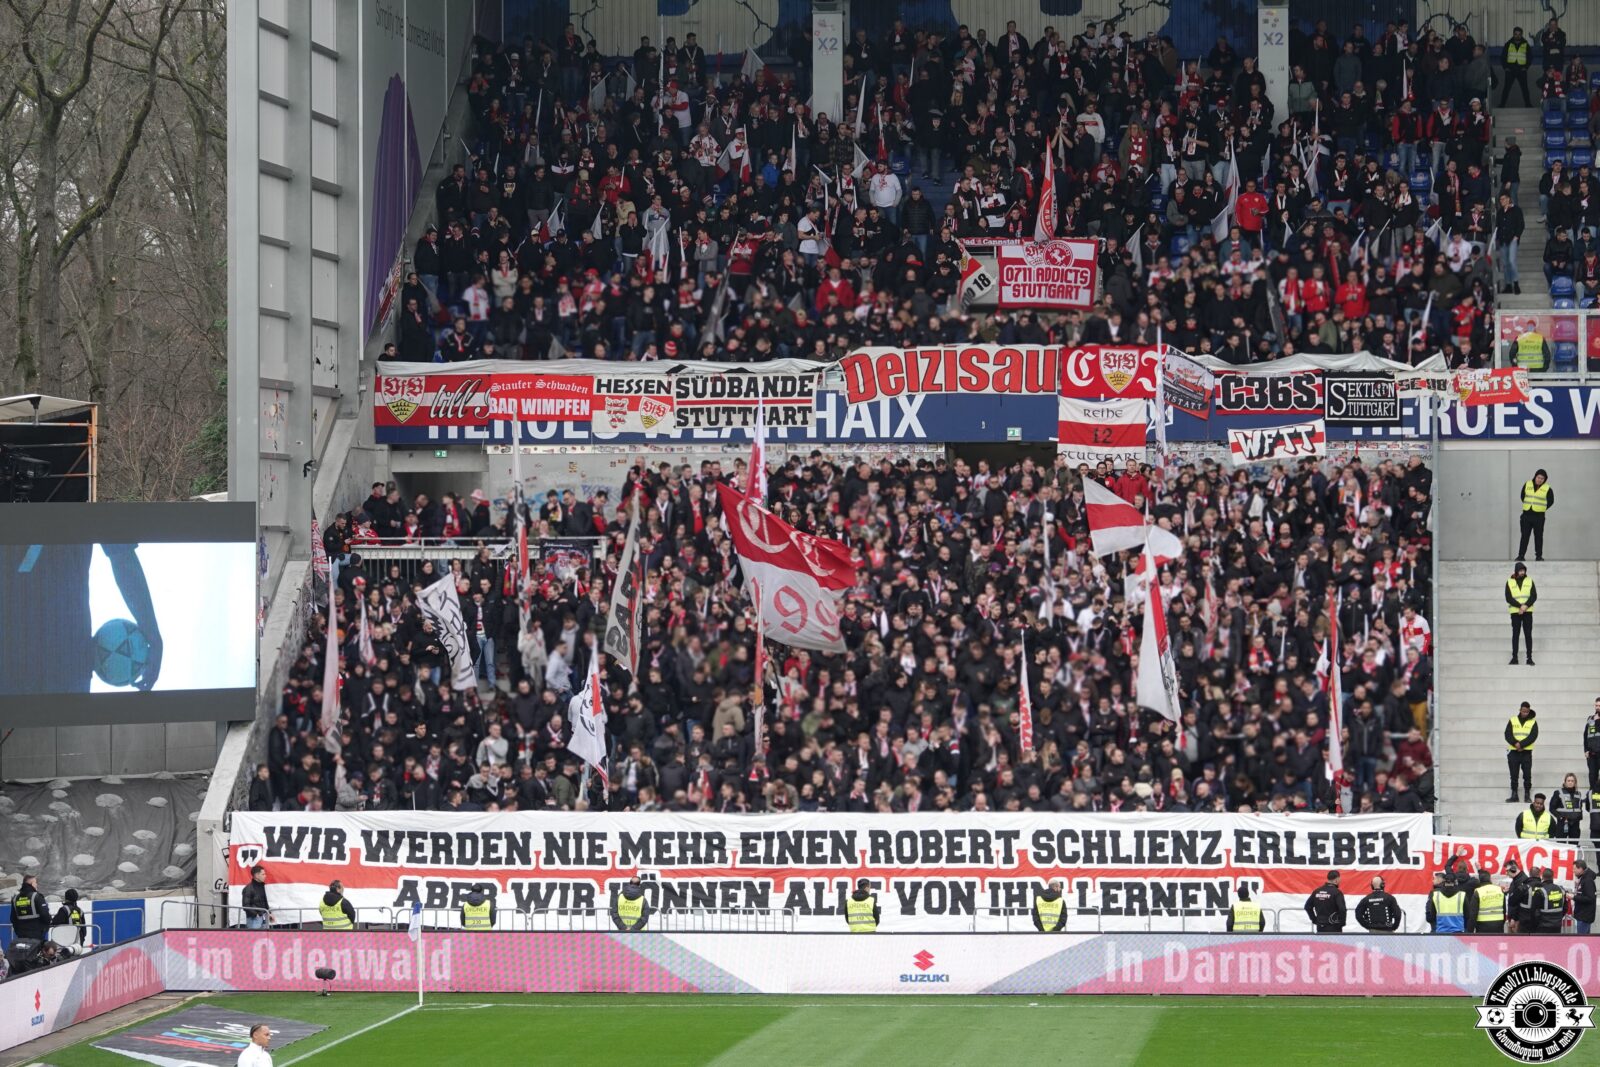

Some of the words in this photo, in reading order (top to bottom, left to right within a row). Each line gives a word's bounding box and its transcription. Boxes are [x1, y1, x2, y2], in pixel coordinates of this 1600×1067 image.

[818, 37, 838, 51] X2
[1263, 33, 1284, 46] X2
[973, 273, 991, 292] 18
[1005, 267, 1033, 282] 0711
[1035, 267, 1089, 284] ADDICTS
[1012, 284, 1081, 300] STUTTGART
[490, 380, 533, 392] Staufer
[535, 379, 589, 394] Schwaben
[596, 378, 672, 395] HESSEN
[675, 375, 815, 399] SÜDBANDE
[1221, 372, 1319, 411] C36S
[488, 397, 518, 414] BAD
[520, 398, 590, 416] WIMPFEN
[676, 406, 813, 427] STUTTGART
[807, 393, 927, 438] HAIX
[360, 829, 532, 866] WERDEN
[540, 831, 608, 866] NIE
[619, 831, 728, 866] MEHR
[740, 830, 857, 865] EINEN
[869, 829, 1020, 864] ROBERT
[1032, 828, 1223, 865] SCHLIENZ
[1234, 829, 1420, 865] ERLEBEN.
[1433, 840, 1576, 881] URBACH
[393, 879, 499, 912] ABER
[511, 881, 596, 916] WIR
[894, 881, 977, 916] VON
[187, 937, 233, 980] im
[252, 937, 452, 981] Odenwad
[1107, 941, 1143, 982] In
[1163, 941, 1383, 984] Darmstadt
[1403, 941, 1479, 985] und
[97, 944, 148, 1002] Darmstadt
[899, 974, 950, 983] SUZUKI
